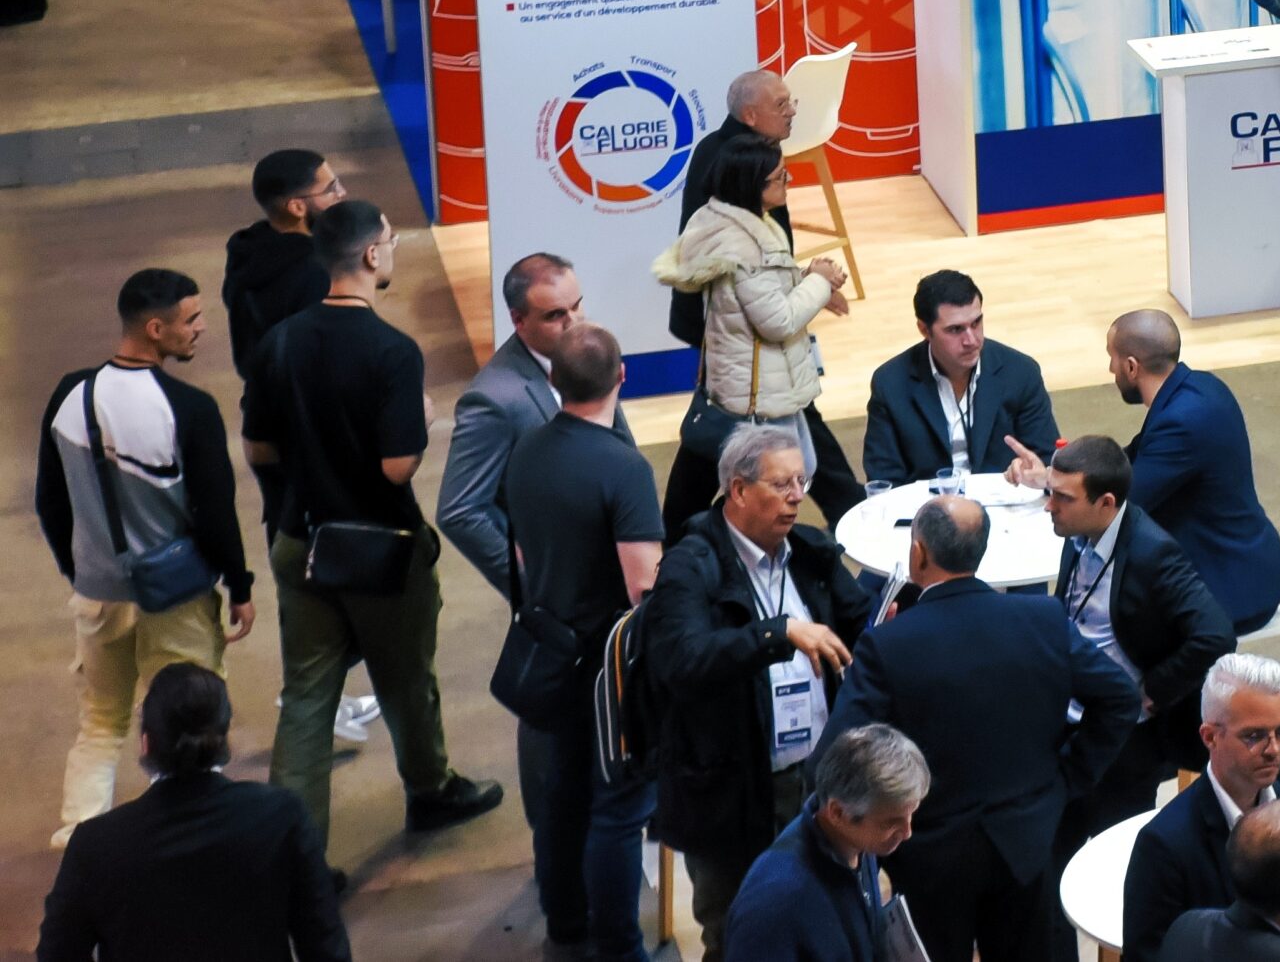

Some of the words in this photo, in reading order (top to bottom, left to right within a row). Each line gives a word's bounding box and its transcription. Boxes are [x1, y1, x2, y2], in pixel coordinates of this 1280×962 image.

[519, 1, 533, 10] Un
[520, 14, 533, 23] au
[535, 11, 572, 21] service
[574, 9, 596, 19] d'un
[598, 1, 677, 17] développement
[573, 62, 605, 82] Achats
[630, 55, 677, 78] Transport
[688, 89, 707, 131] Stockage
[580, 120, 668, 141] CALORIE
[598, 132, 668, 153] FLUOR
